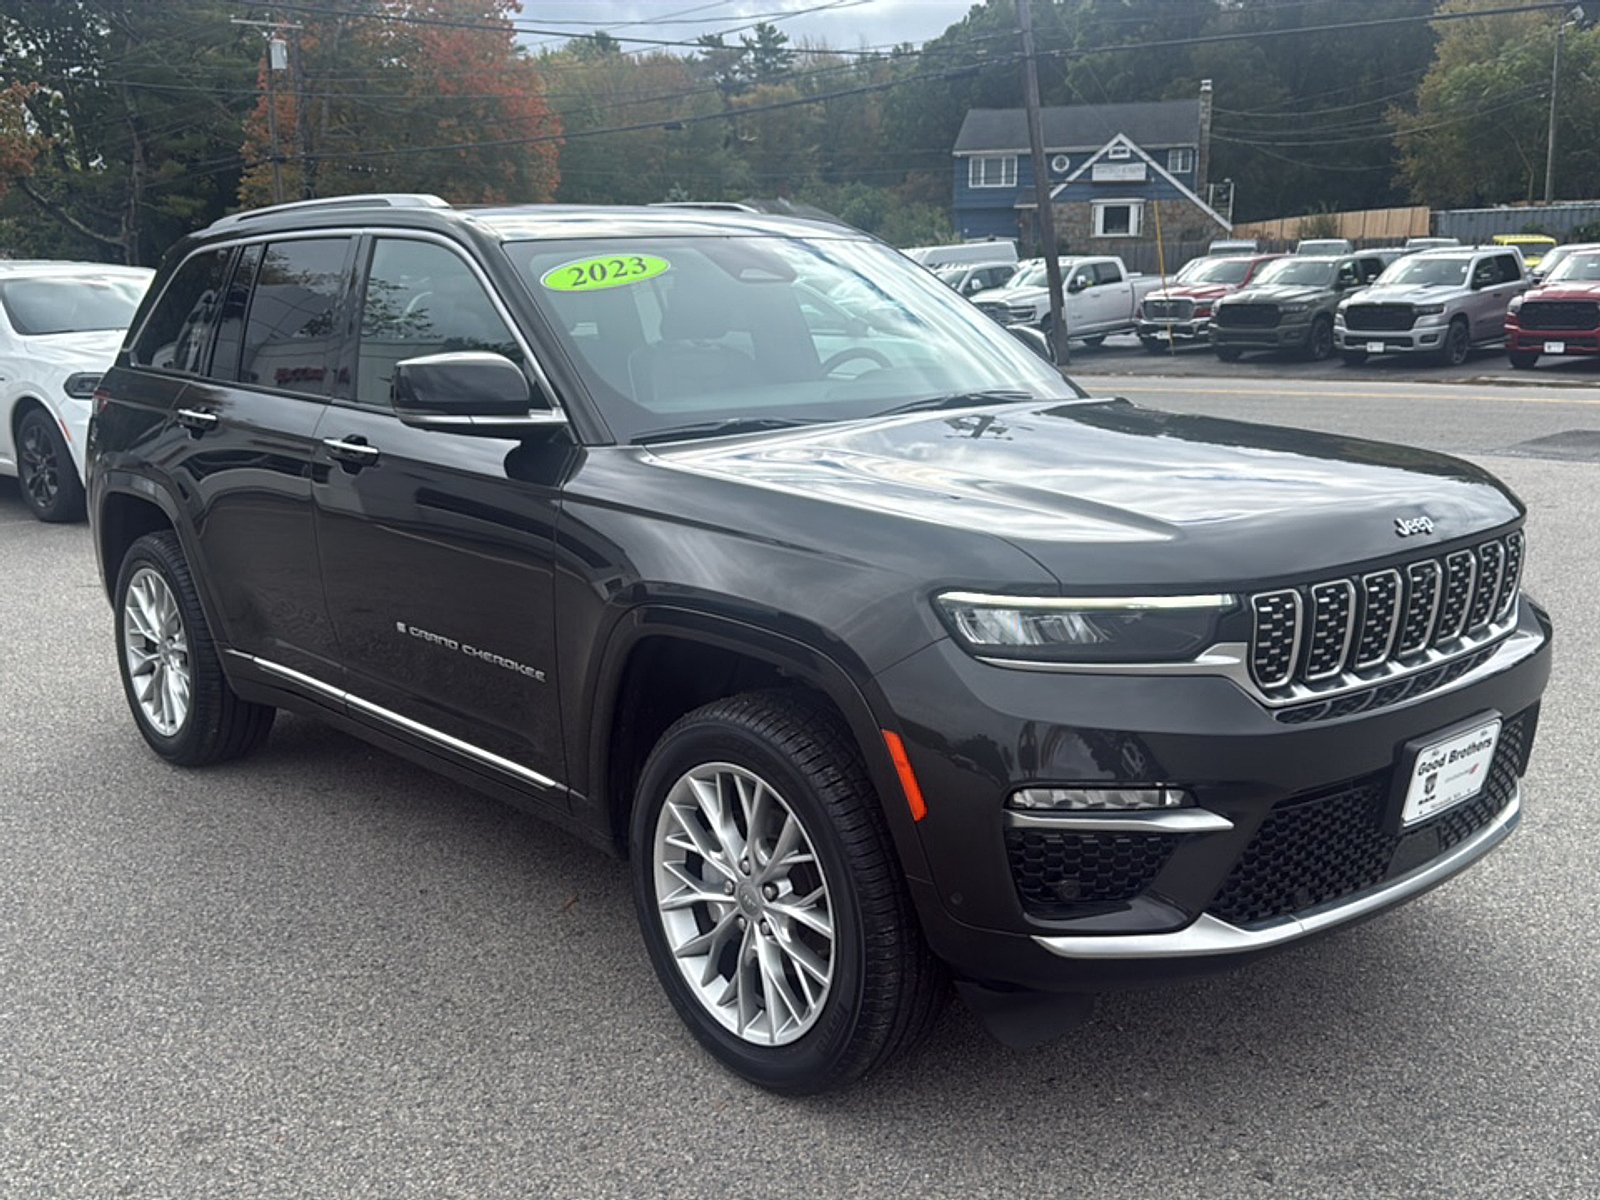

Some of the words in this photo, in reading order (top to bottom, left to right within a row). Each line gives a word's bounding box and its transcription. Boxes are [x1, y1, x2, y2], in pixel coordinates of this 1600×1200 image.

[567, 256, 648, 287] 2023
[1395, 516, 1434, 535] Jeep
[408, 626, 459, 651] GRAND
[461, 643, 547, 683] CHEROKEE
[1418, 753, 1447, 776] Good
[1448, 737, 1493, 764] Brothers
